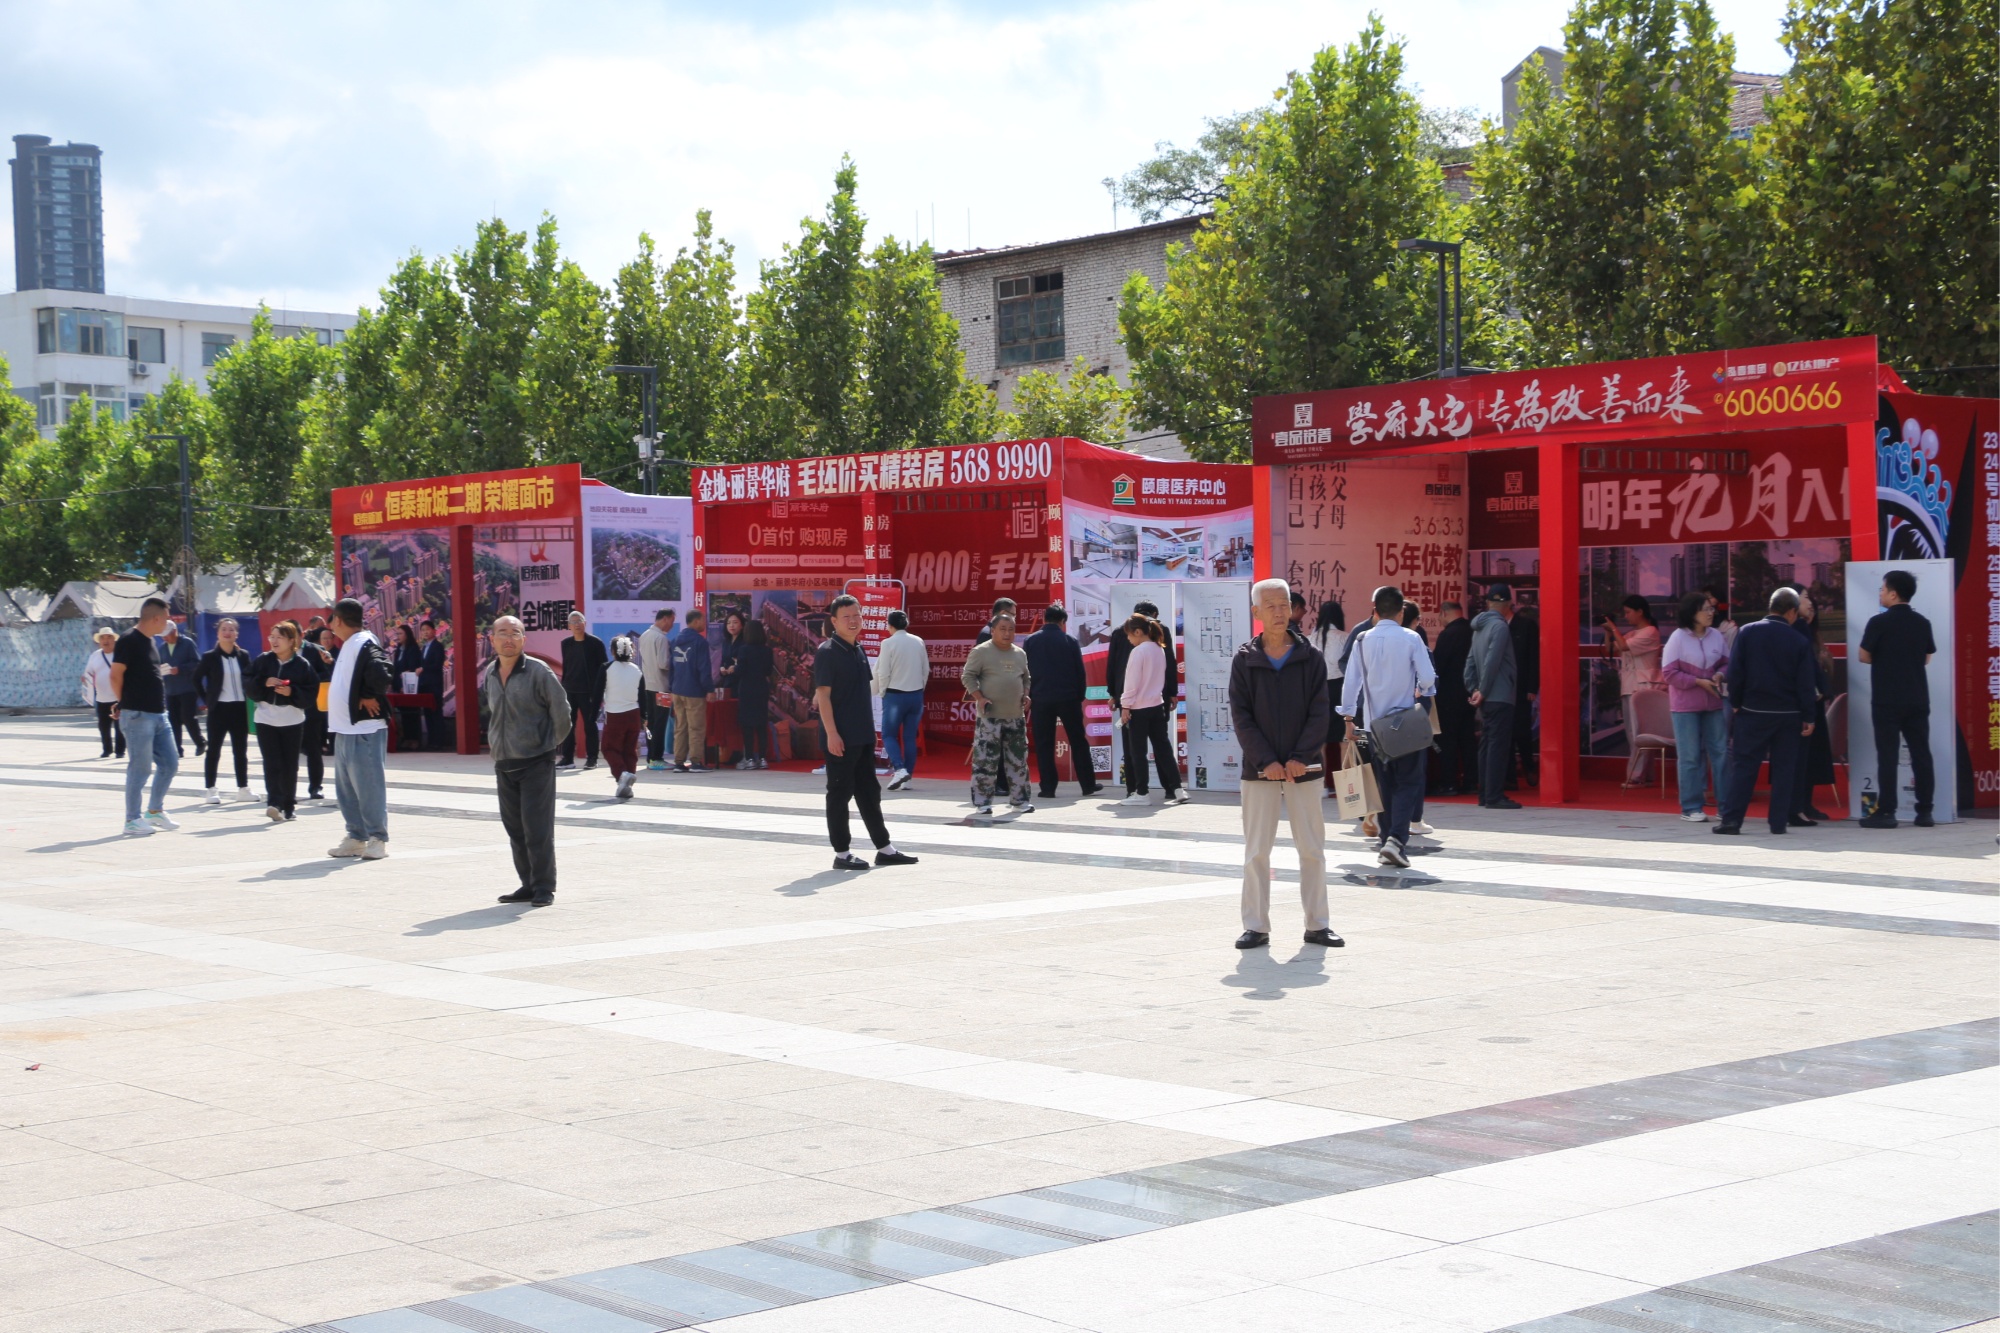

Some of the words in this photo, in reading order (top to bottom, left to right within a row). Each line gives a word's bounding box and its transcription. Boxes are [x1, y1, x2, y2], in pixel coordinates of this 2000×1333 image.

[1724, 381, 1842, 417] 6060666
[797, 449, 945, 496] 毛坯价买精装房
[950, 447, 991, 485] 568
[996, 441, 1052, 481] 9990
[1142, 477, 1226, 495] 颐康医养中心
[385, 482, 482, 521] 恒泰新城二期
[484, 475, 554, 513] 荣耀面市
[748, 523, 795, 547] 0首付
[800, 527, 848, 547] 购现房
[521, 564, 560, 581] 恒泰新城
[694, 535, 704, 607] 0首付
[901, 550, 970, 593] 4800
[1376, 542, 1463, 577] 15年优教
[1196, 755, 1203, 766] 3
[1863, 777, 1872, 790] 2
